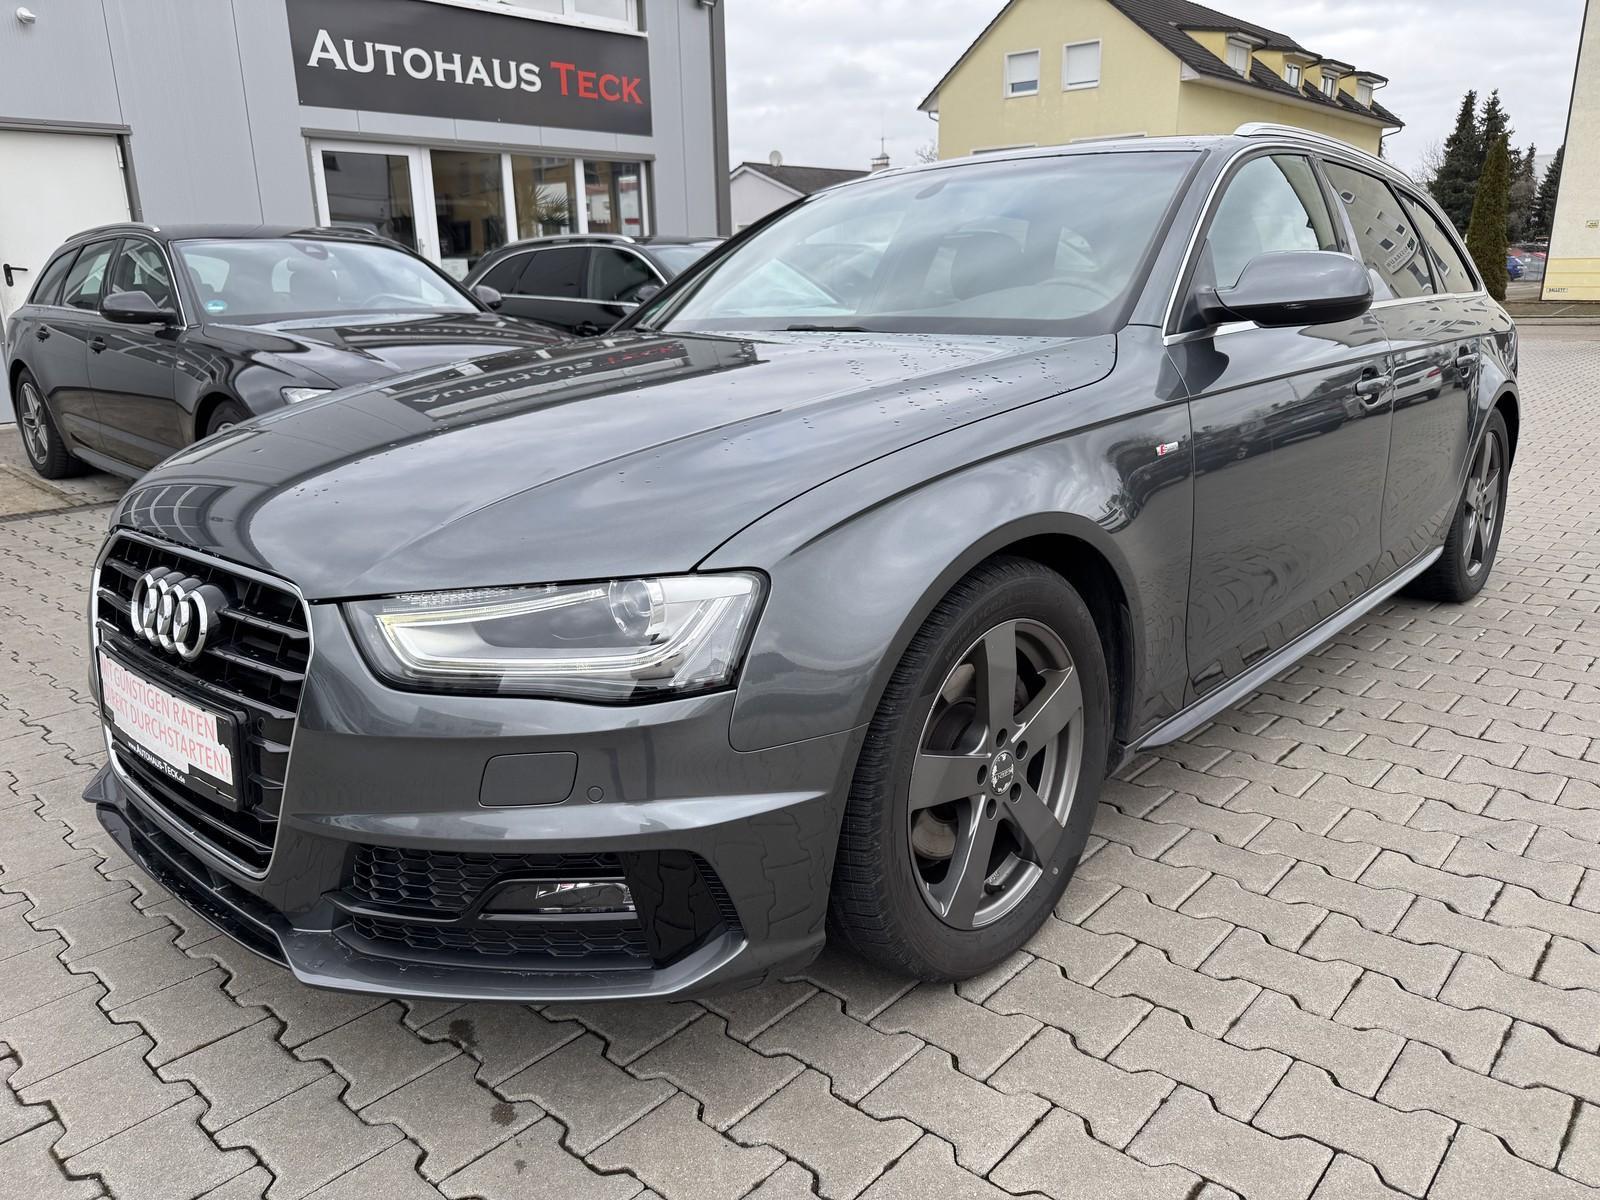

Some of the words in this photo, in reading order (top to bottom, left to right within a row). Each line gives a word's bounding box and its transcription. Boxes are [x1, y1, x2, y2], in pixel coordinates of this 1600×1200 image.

[307, 29, 542, 92] AUTOHAUS
[550, 61, 643, 104] TECK
[131, 705, 229, 775] DURCHSTARTEN!
[173, 705, 216, 742] RATEN
